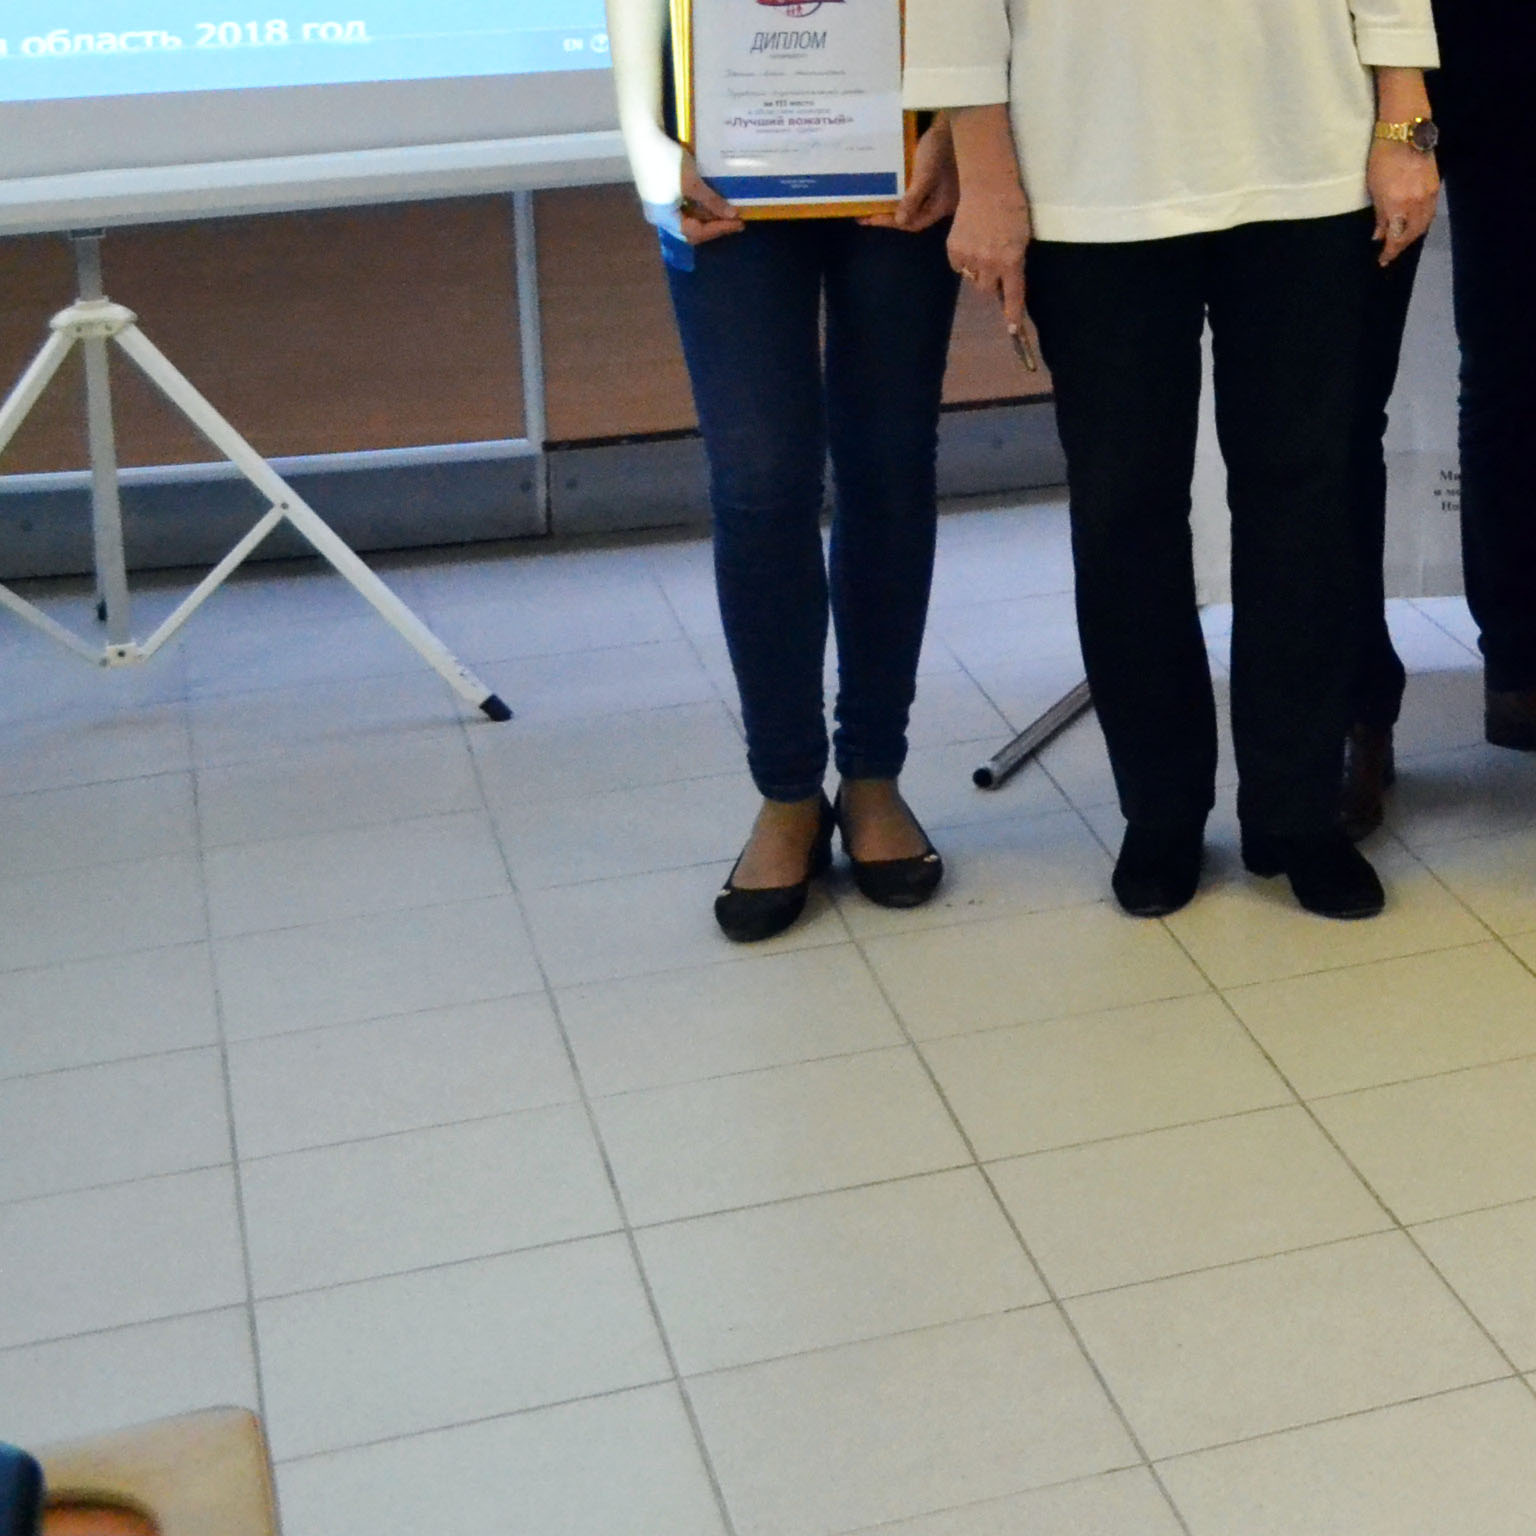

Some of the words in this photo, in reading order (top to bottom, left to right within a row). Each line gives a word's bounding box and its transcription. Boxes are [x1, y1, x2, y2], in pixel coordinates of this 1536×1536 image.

[21, 28, 183, 56] область
[195, 19, 290, 48] 2018
[301, 20, 370, 44] год
[751, 31, 828, 54] ДИПЛОМ
